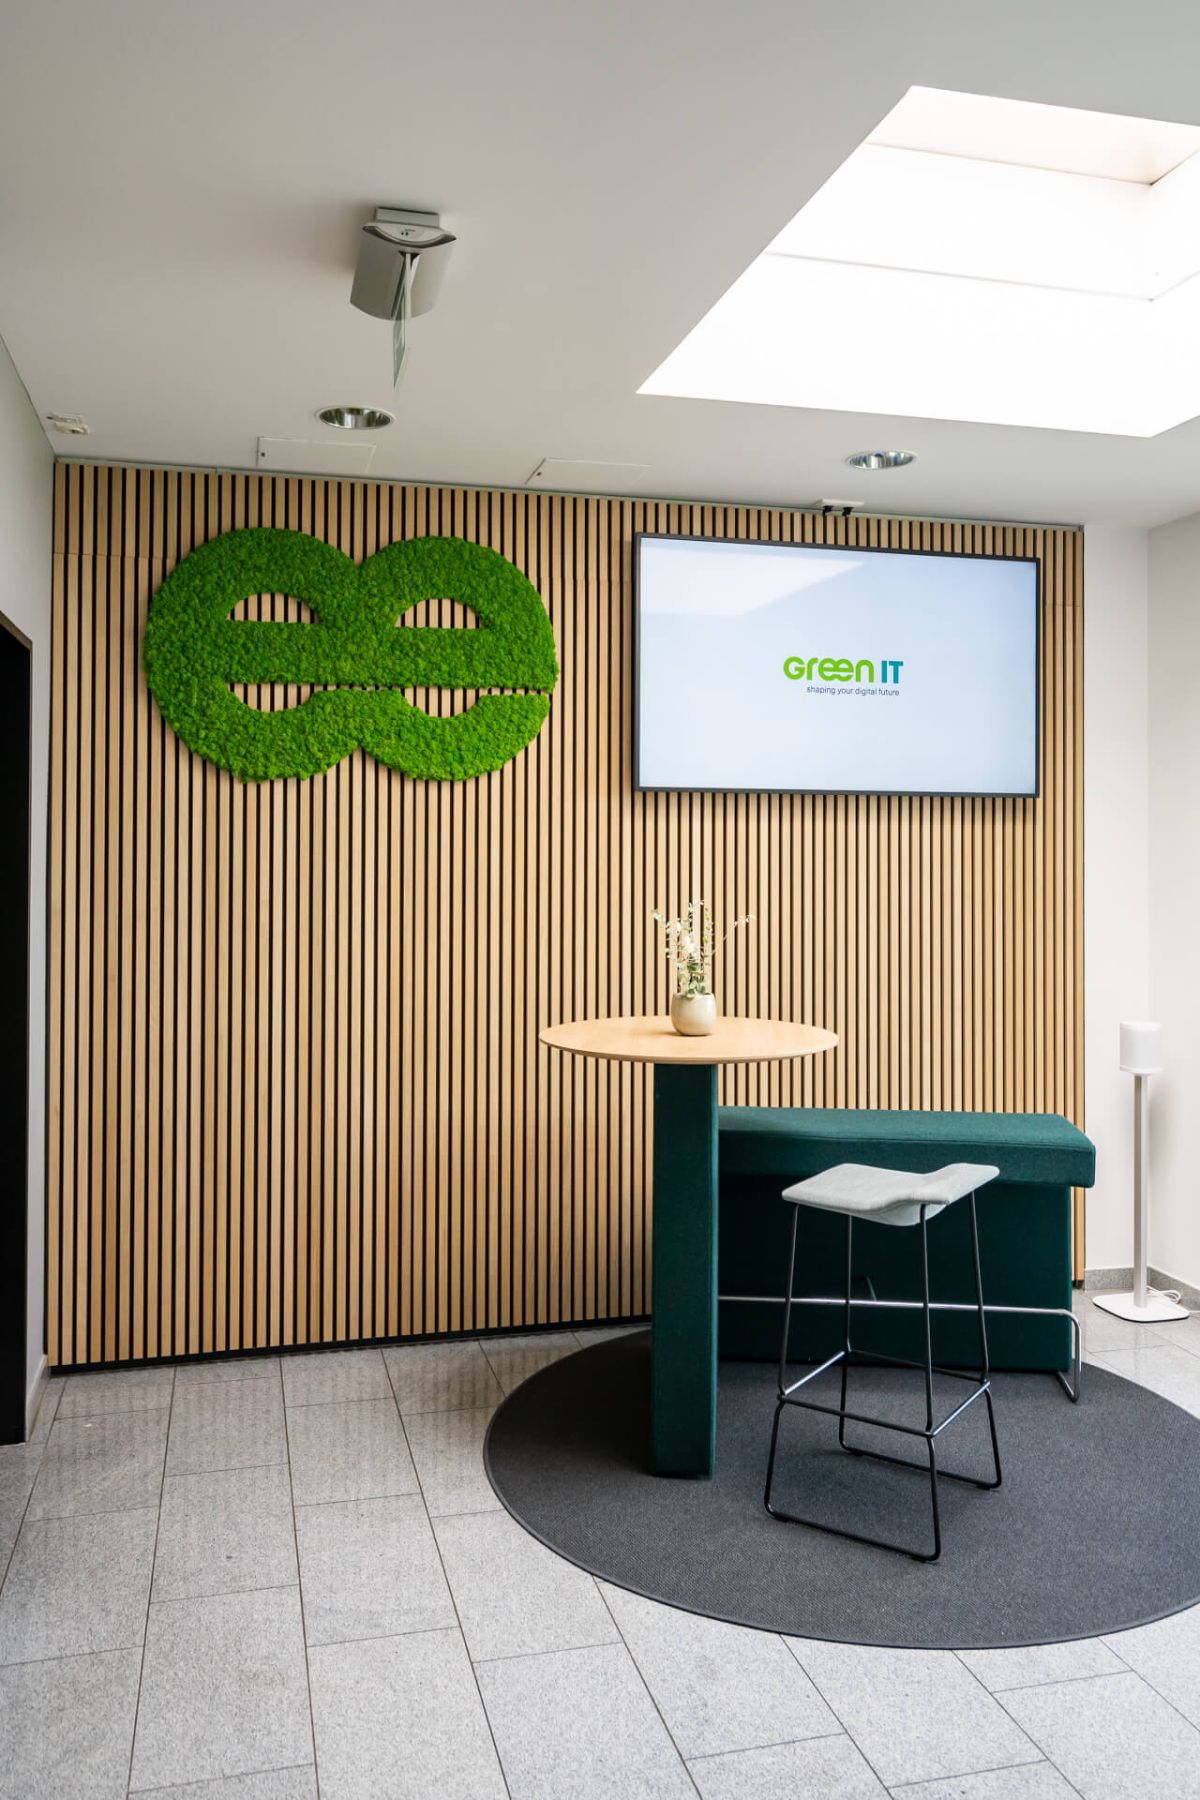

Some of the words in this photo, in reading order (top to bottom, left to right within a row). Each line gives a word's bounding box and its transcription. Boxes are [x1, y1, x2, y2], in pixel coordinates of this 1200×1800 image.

[783, 656, 875, 683] Green
[881, 660, 904, 683] IT
[806, 686, 836, 695] shaping
[854, 686, 877, 696] digital
[878, 687, 900, 696] future
